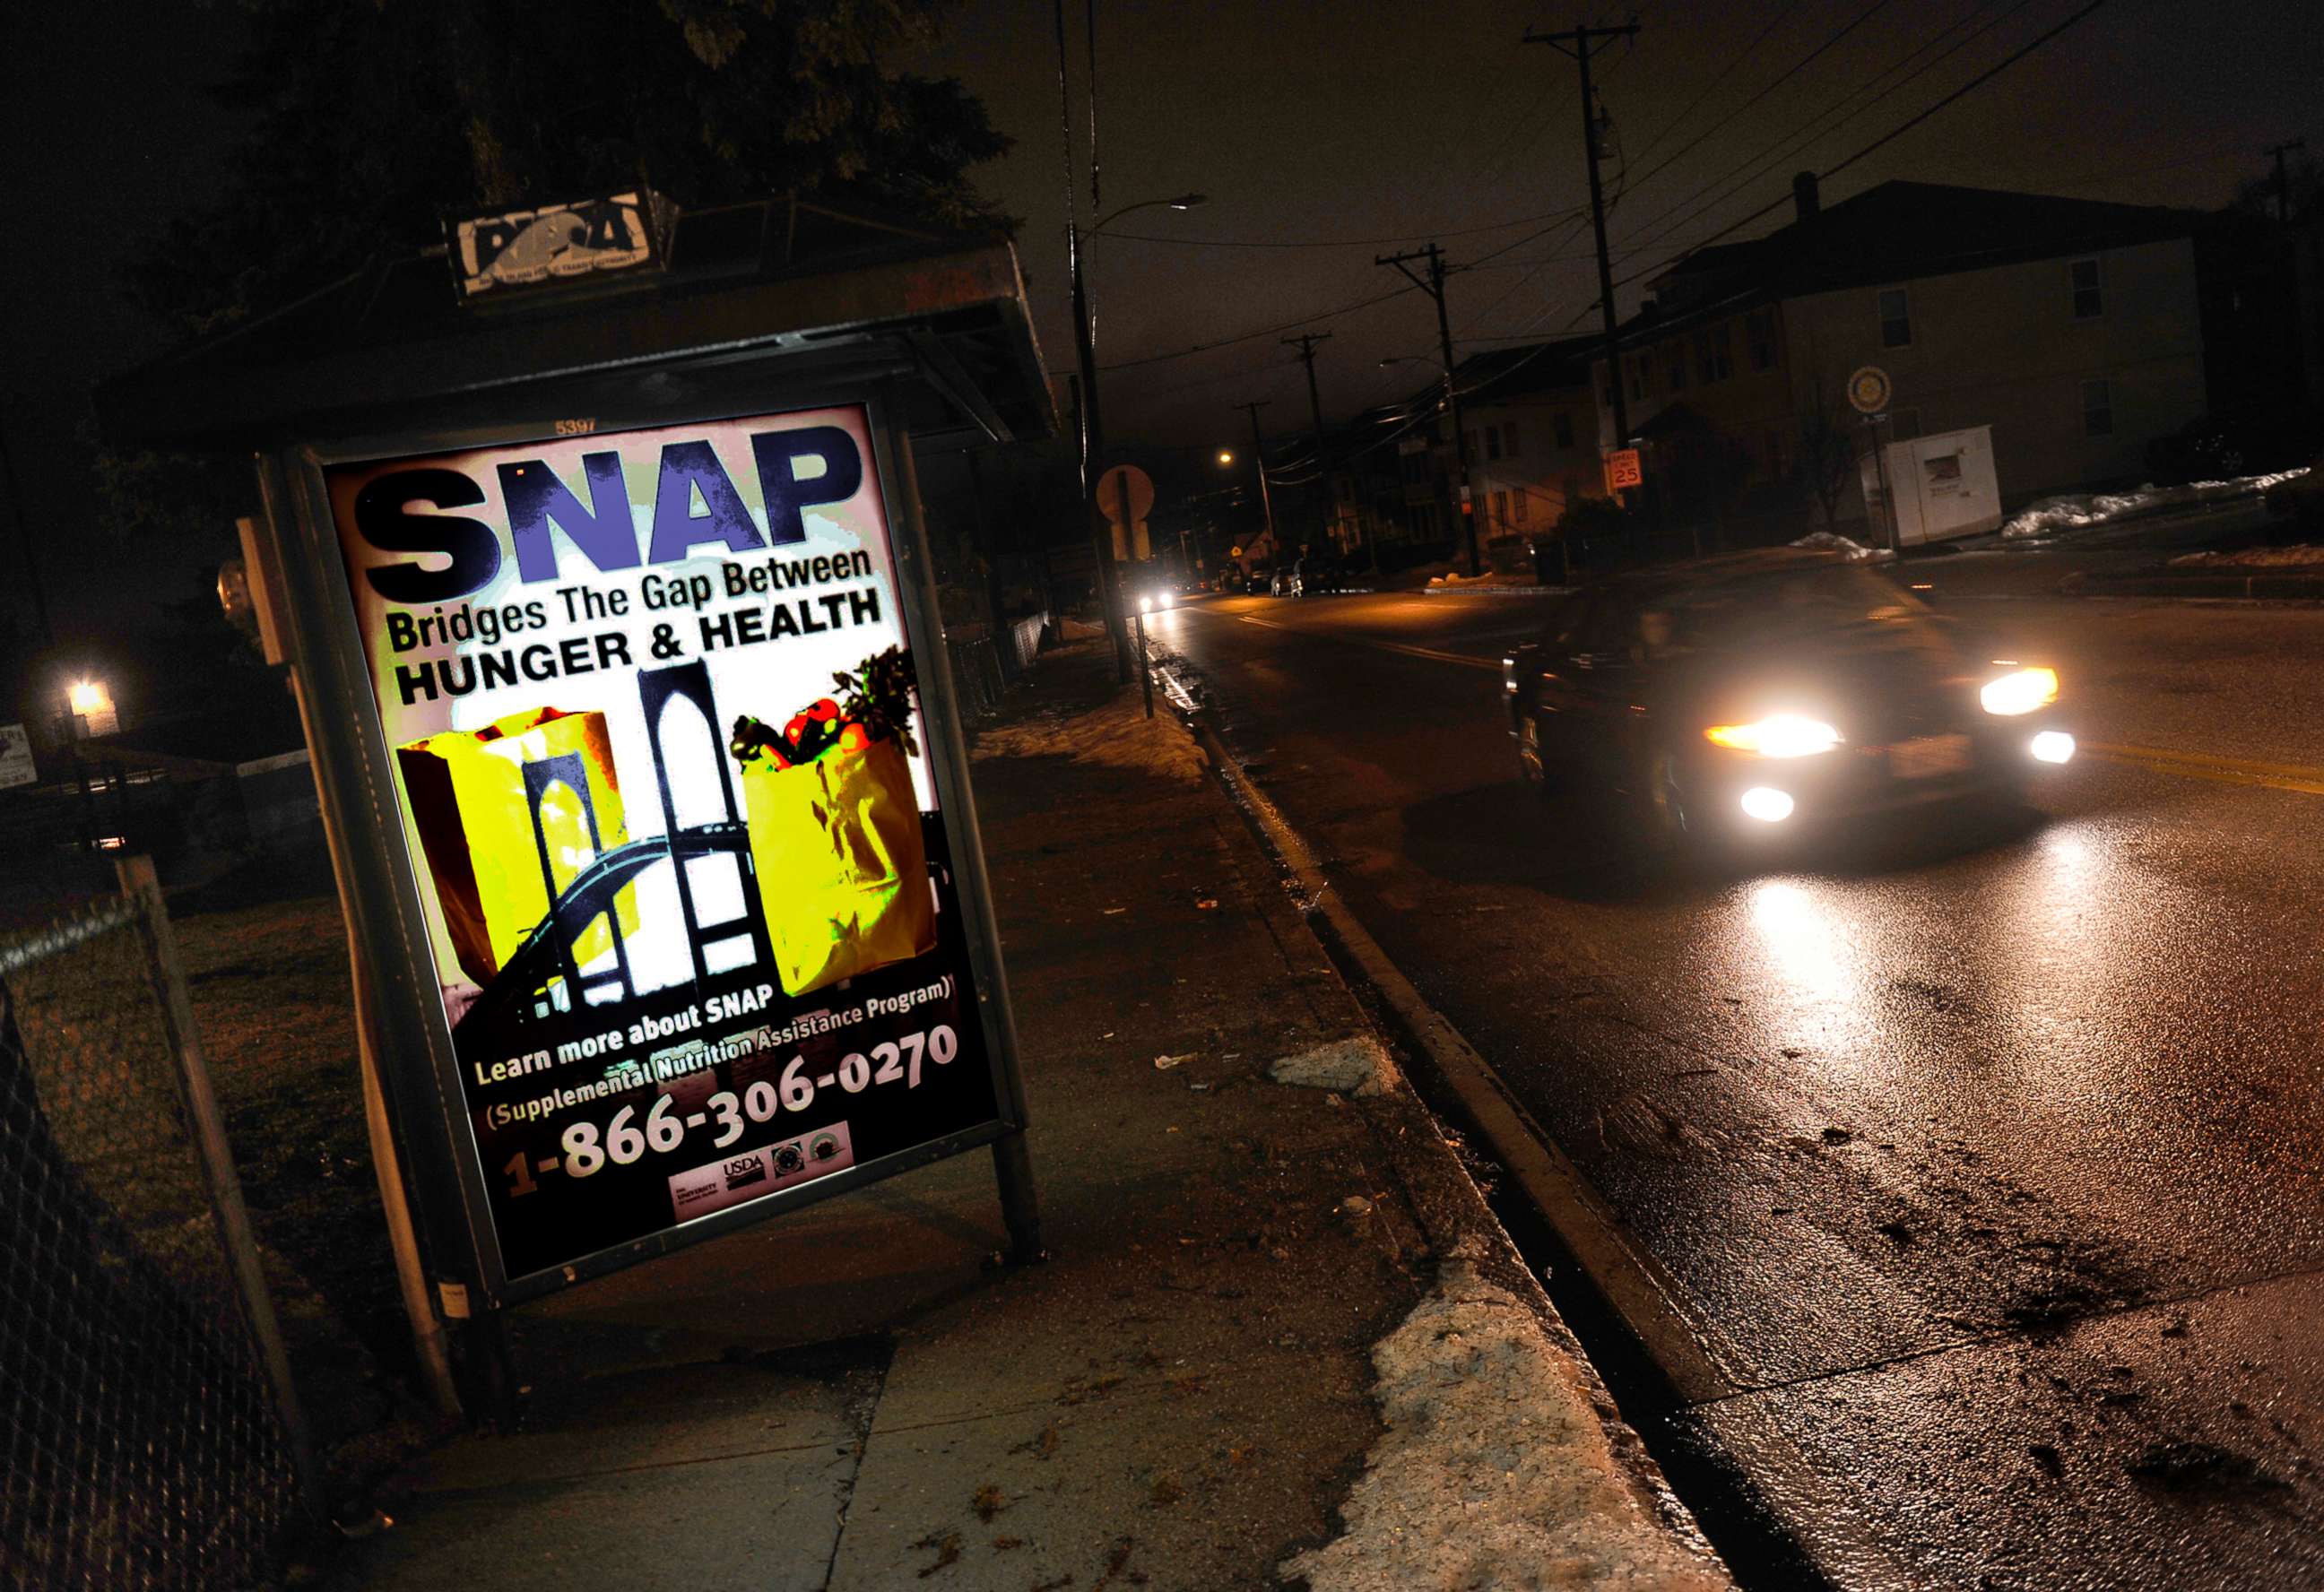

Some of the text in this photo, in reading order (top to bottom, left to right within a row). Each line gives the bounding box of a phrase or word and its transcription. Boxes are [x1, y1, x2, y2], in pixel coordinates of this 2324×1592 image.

[355, 426, 863, 603] SNAP
[1615, 468, 1639, 483] 25
[386, 549, 872, 653] Bridges The Gap Between
[395, 588, 880, 705] HUNGER & HEALTH
[474, 984, 773, 1086] Learn more about SNAP
[487, 975, 950, 1130] (Supplemental Nutrition Assistance Program)
[503, 1025, 958, 1198] 1-866-306-0270
[724, 1155, 764, 1176] USDA
